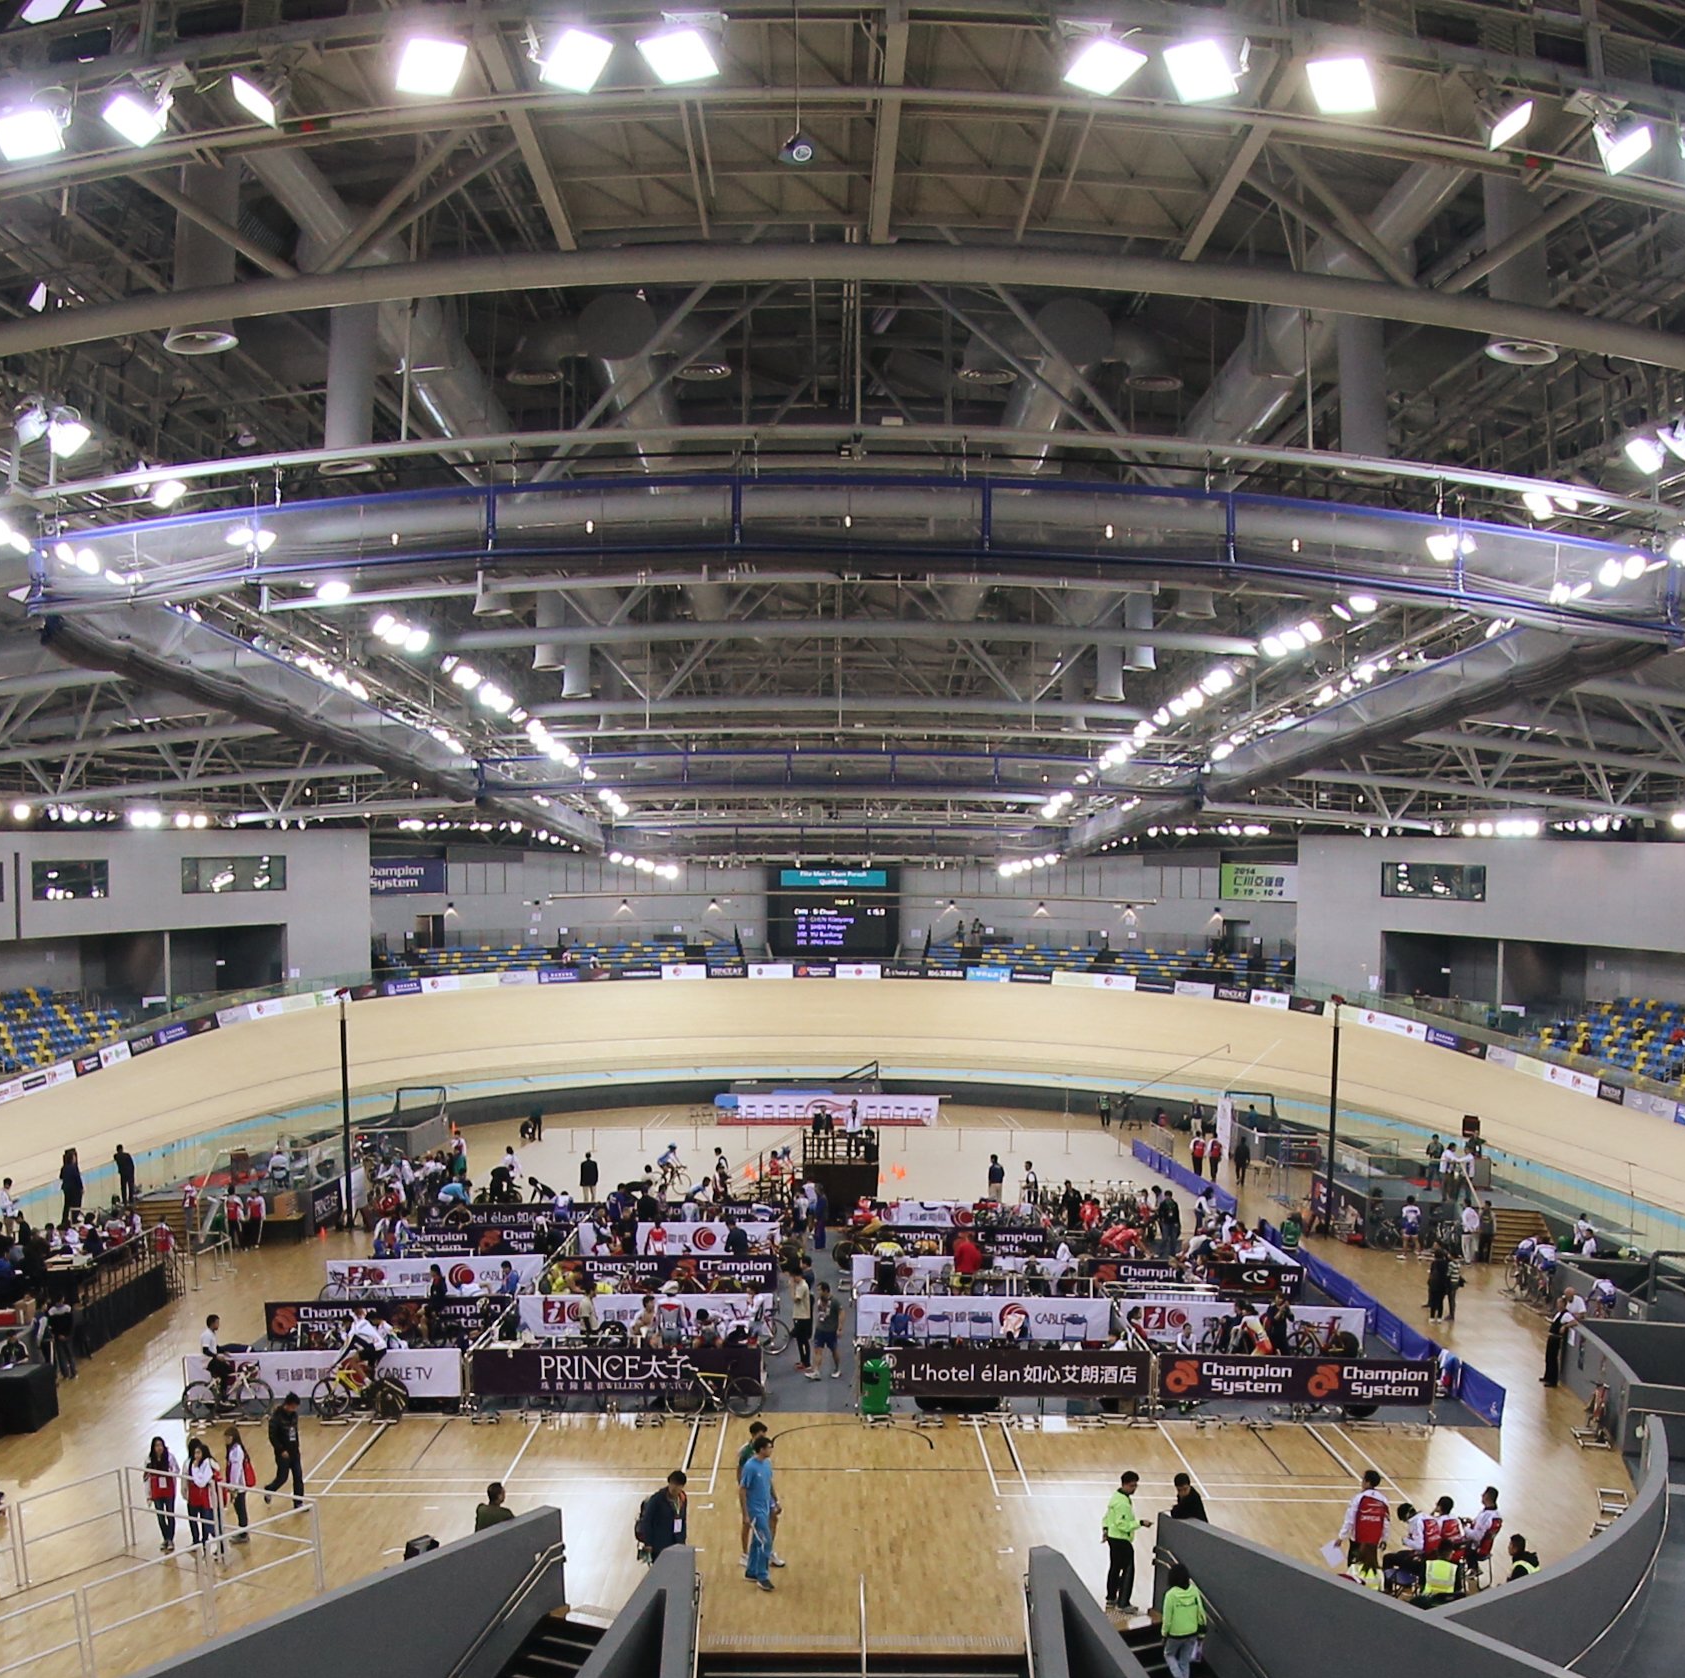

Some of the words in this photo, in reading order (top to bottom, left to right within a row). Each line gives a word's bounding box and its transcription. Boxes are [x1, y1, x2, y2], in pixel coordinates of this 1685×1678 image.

[370, 865, 424, 878] hampion
[370, 878, 419, 890] System
[978, 1231, 1043, 1244] Campion
[377, 1366, 411, 1380] CABLE
[414, 1366, 433, 1380] TV
[540, 1355, 642, 1380] PRINCE
[911, 1364, 974, 1382] L'hotel
[981, 1363, 1020, 1382] élan
[1023, 1365, 1137, 1384] 如心艾朗酒店
[1202, 1362, 1292, 1381] Champion
[1342, 1363, 1429, 1383] Champion
[1211, 1377, 1282, 1394] System
[1350, 1381, 1419, 1398] System
